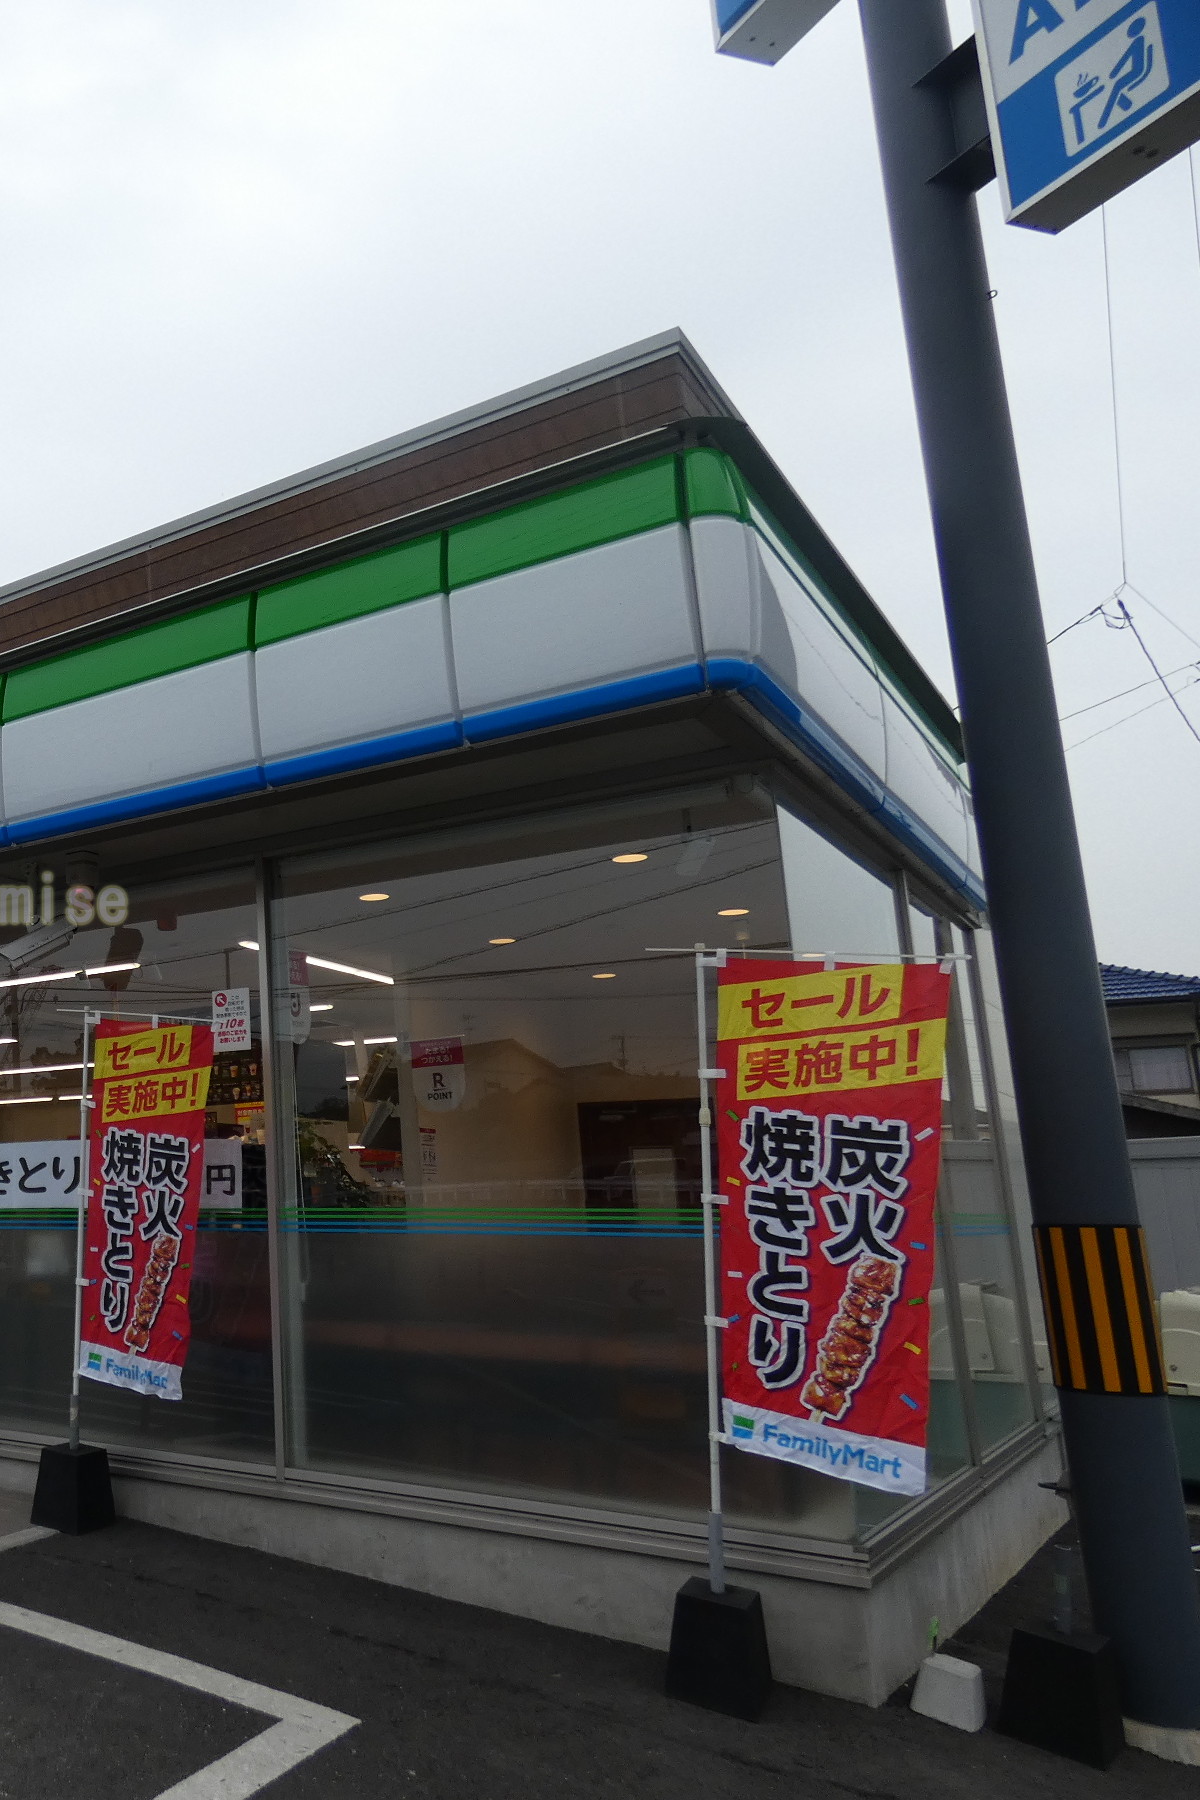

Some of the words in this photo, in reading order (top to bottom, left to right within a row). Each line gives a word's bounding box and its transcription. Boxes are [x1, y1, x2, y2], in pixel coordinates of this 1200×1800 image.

[741, 974, 891, 1028] セール
[107, 1032, 186, 1071] セール
[742, 1028, 922, 1094] 実施中!
[105, 1073, 199, 1116] 実施中!
[427, 1091, 453, 1101] POINT
[432, 1072, 446, 1089] R
[141, 1133, 190, 1241] 炭火
[206, 1164, 236, 1196] 円
[820, 1115, 910, 1263] 炭火
[102, 1127, 145, 1332] 焼きとり
[740, 1107, 819, 1389] 焼きとり
[762, 1423, 902, 1479] FamilyMart
